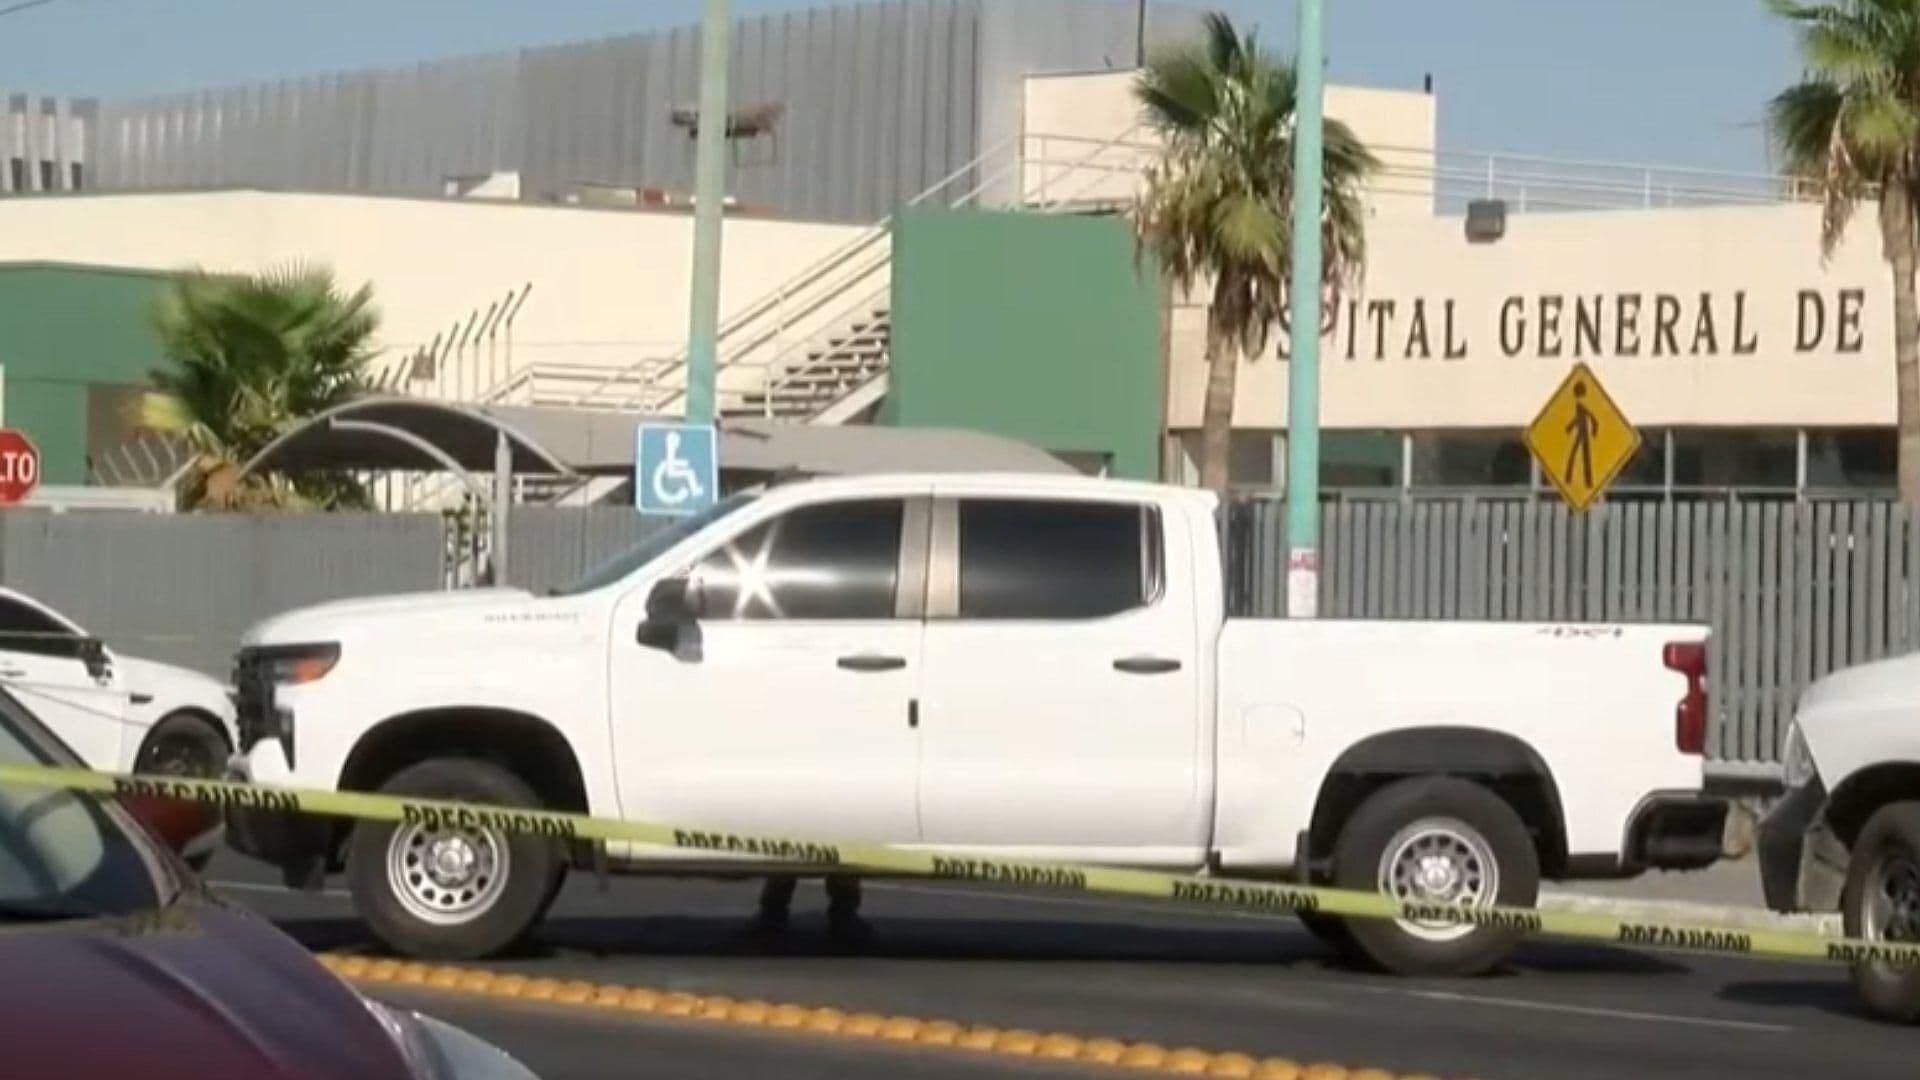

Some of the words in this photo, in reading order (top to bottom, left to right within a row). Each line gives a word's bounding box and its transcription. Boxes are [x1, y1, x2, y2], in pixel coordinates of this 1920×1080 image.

[1206, 297, 1467, 362] OSITAL
[1499, 290, 1758, 358] GENERAL
[1795, 288, 1864, 355] DE
[0, 451, 36, 484] TO
